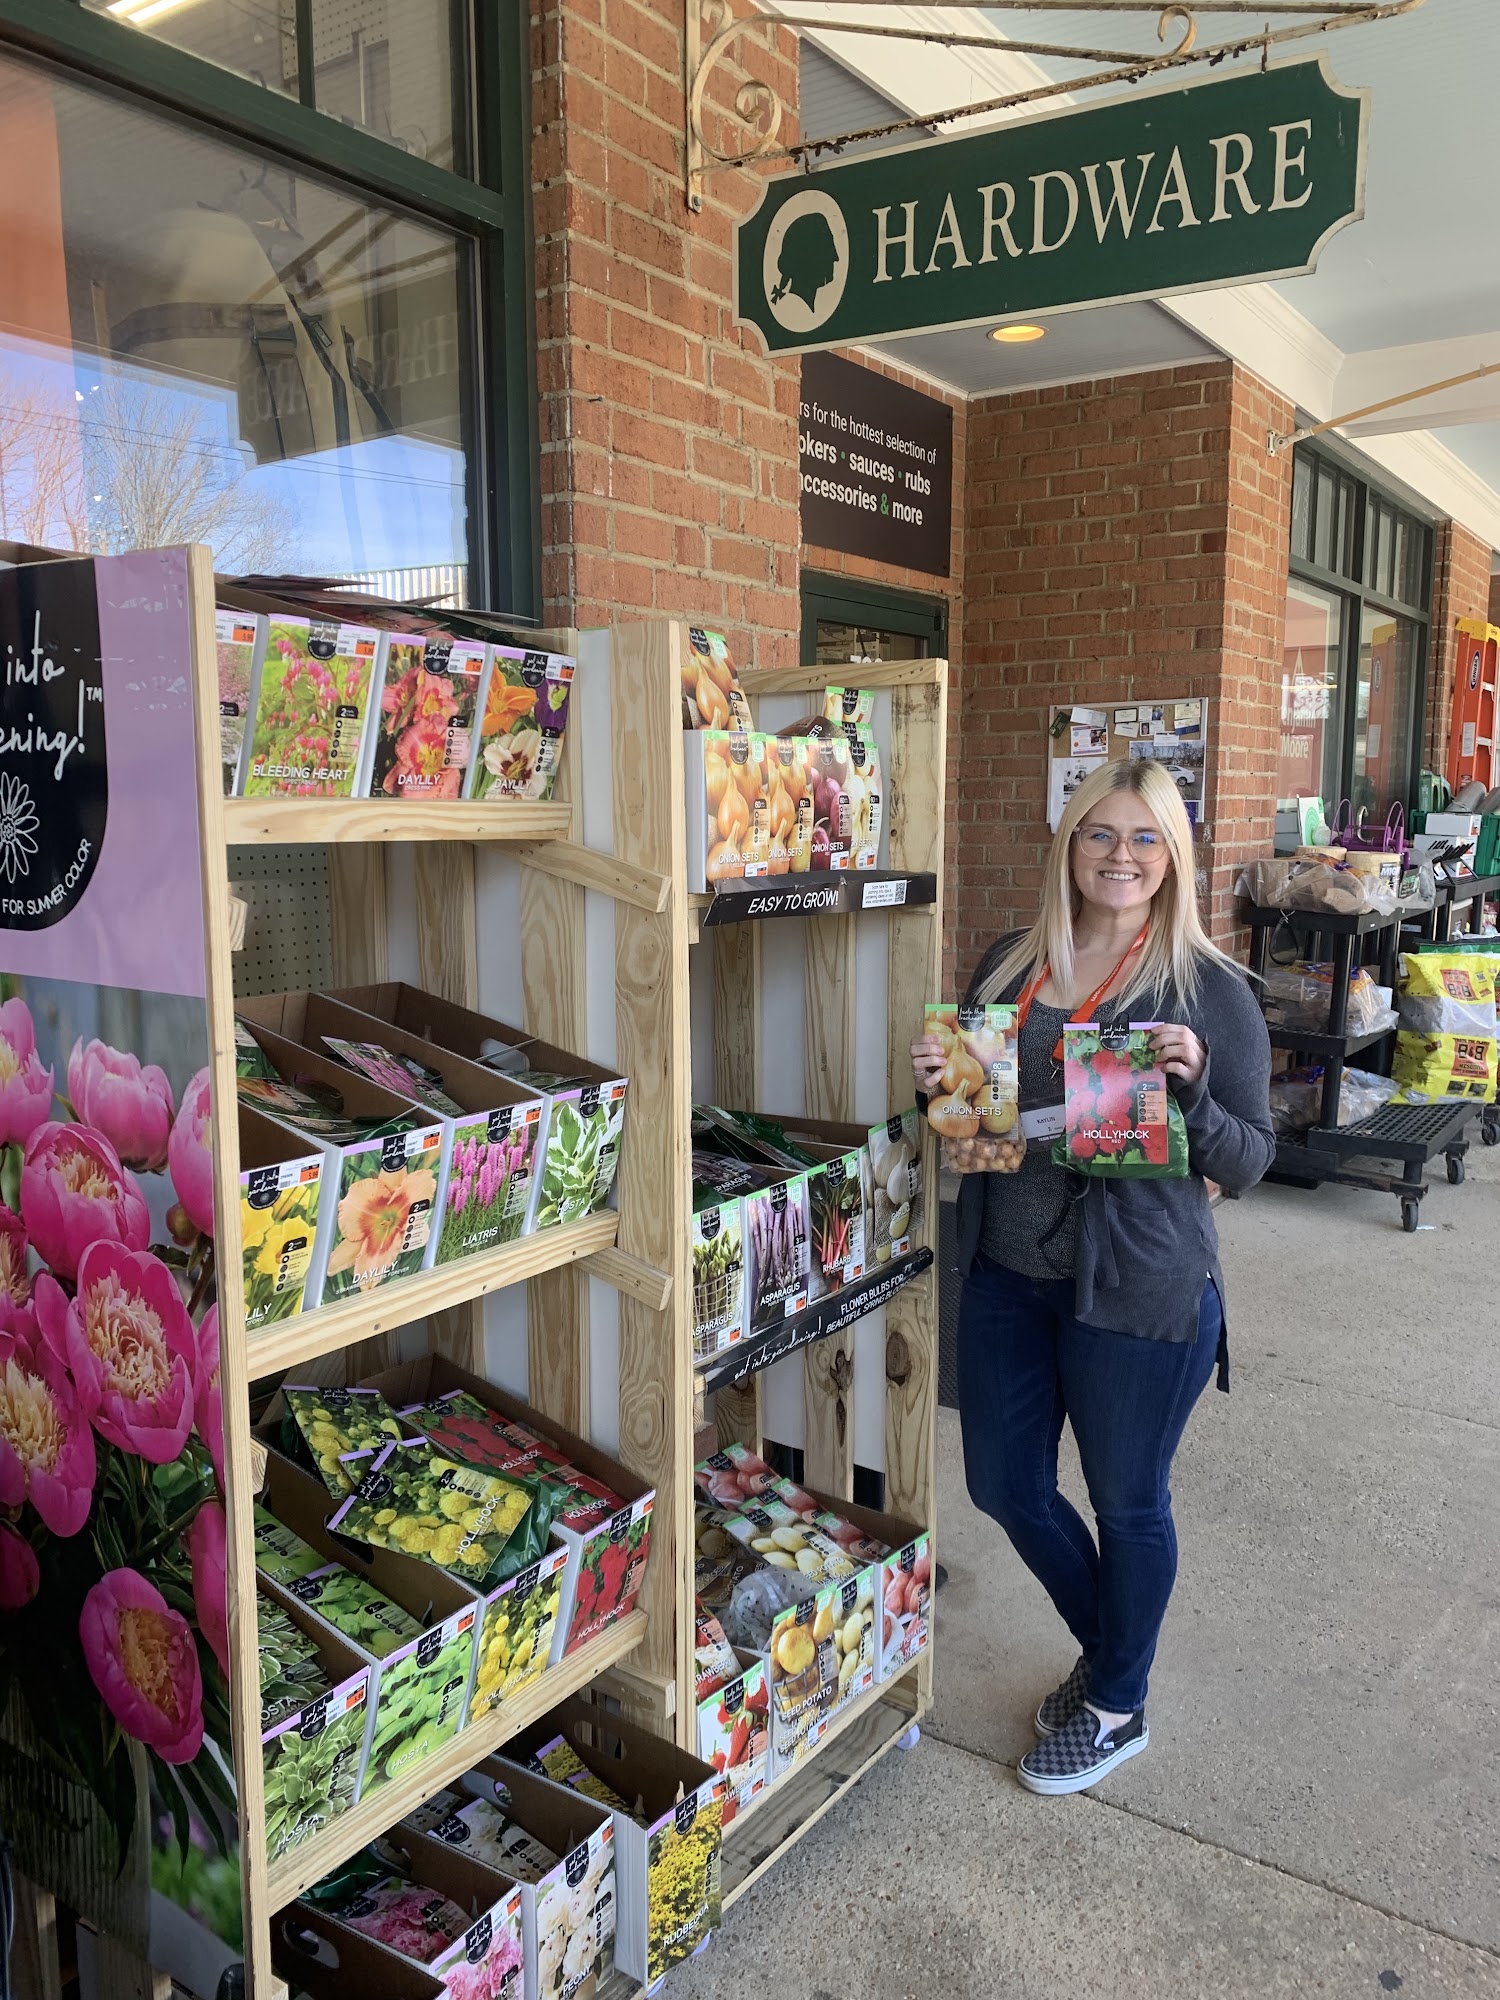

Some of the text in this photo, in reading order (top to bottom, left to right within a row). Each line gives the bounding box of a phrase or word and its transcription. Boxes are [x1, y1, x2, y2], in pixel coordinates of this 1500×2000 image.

[873, 118, 1313, 283] HARDWARE
[813, 402, 828, 425] for
[831, 410, 847, 431] the
[850, 415, 884, 446] hottest
[886, 433, 926, 460] selection
[927, 448, 937, 465] of
[849, 452, 895, 483] sauces
[905, 470, 931, 495] rubs
[880, 492, 889, 515] &
[893, 501, 923, 525] more
[7, 609, 66, 686] into
[1471, 656, 1480, 684] WERNER
[341, 707, 347, 717] 2
[1281, 733, 1309, 758] Moore
[253, 764, 350, 781] BLEEDING HEART
[398, 774, 441, 785] DAYLILY
[494, 779, 532, 790] DAYLILY
[718, 852, 759, 864] ONION SETS
[768, 848, 802, 859] ONION SETS
[811, 843, 829, 853] ONION
[829, 842, 844, 851] SETS
[2, 838, 92, 915] FOR SUMMER COLOR
[748, 889, 839, 914] EASY TO GROW!
[1104, 1025, 1113, 1034] get
[942, 1105, 1002, 1116] ONION SETS
[1083, 1130, 1150, 1139] HOLLYHOCK
[511, 1173, 519, 1182] 16
[413, 1204, 420, 1213] 2
[557, 1197, 586, 1215] HOSTA
[288, 1242, 294, 1251] 2
[462, 1227, 498, 1247] LIATRIS
[352, 1260, 399, 1284] DAYLILY
[387, 1267, 410, 1279] FOREVER
[728, 1264, 733, 1272] 3
[823, 1255, 850, 1274] RHUBARB
[760, 1282, 801, 1306] ASPARAGUS
[840, 1273, 904, 1315] FLOWER BULBS FOR
[245, 1303, 272, 1321] LILY
[826, 1294, 885, 1334] BEAUTIFUL SPRING
[692, 1312, 733, 1337] ASPARAGUS
[499, 1449, 543, 1471] HOLLYHOCK
[440, 1476, 449, 1485] 2
[566, 1498, 612, 1520] HOLLYHOCK
[257, 1529, 266, 1537] 2
[455, 1495, 500, 1555] HOLLYHOCK
[369, 1605, 376, 1613] 2
[577, 1602, 625, 1640] HOLLYHOCK
[480, 1667, 534, 1706] HOLLYHOCK
[782, 1704, 801, 1720] SEED
[803, 1686, 832, 1708] POTATO
[338, 1752, 345, 1761] 2
[391, 1740, 428, 1771] HOSTA
[277, 1814, 320, 1850] HOSTA
[663, 1903, 709, 1948] RUDBECKIA
[563, 1963, 592, 1996] PEONY
